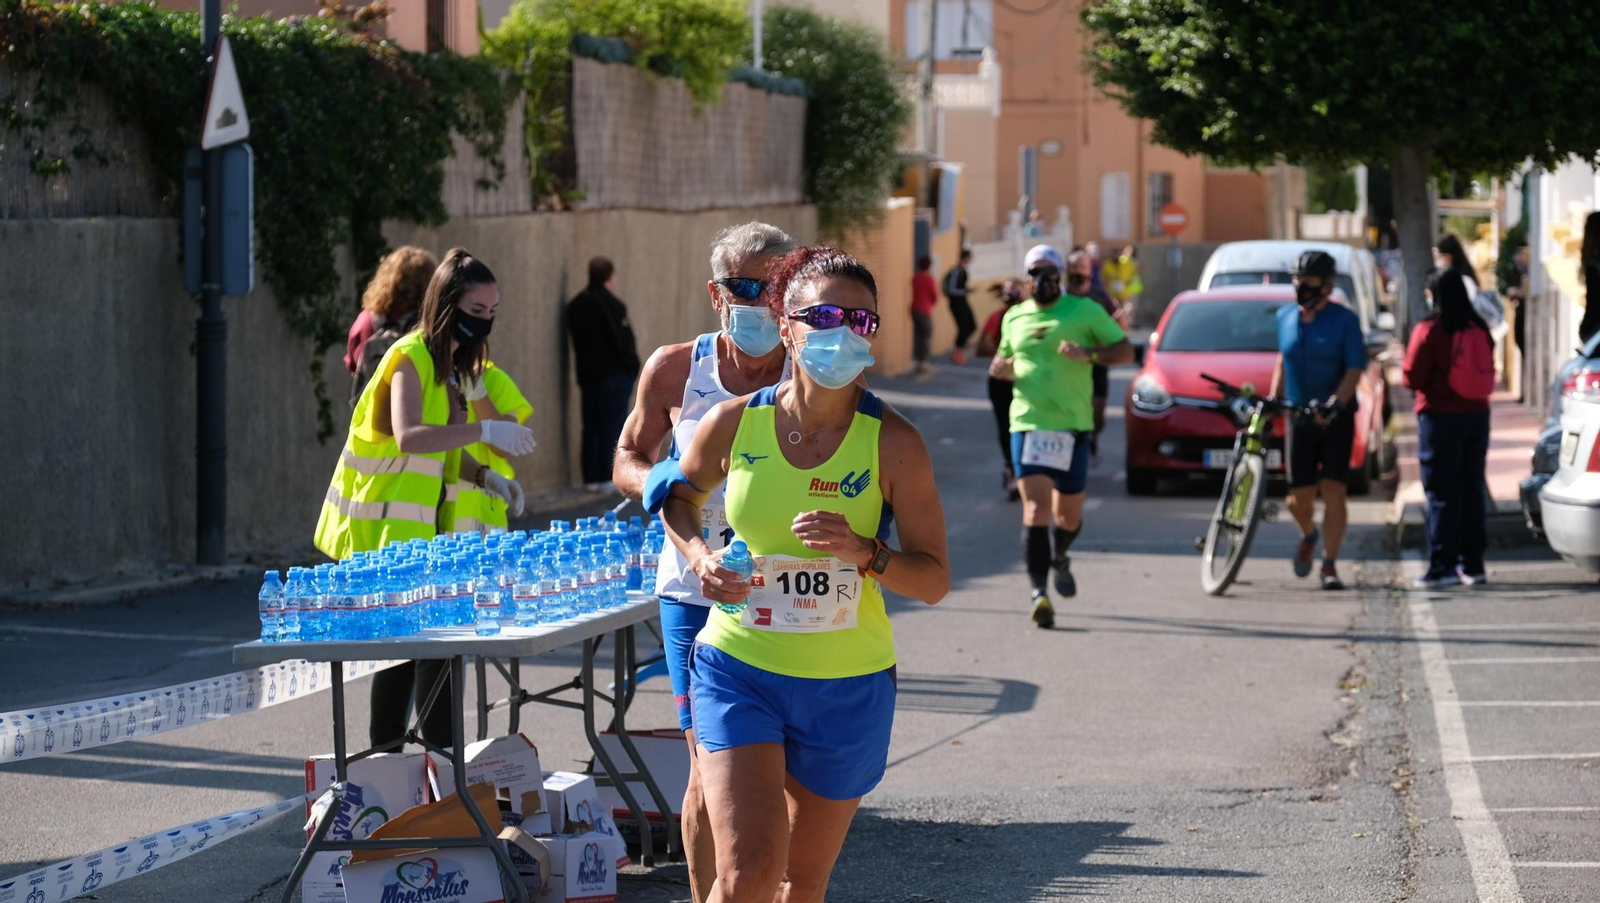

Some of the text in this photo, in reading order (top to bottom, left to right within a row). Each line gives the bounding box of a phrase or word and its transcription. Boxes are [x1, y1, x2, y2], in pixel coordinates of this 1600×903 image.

[809, 477, 839, 492] Run
[842, 484, 857, 496] 04
[776, 571, 830, 596] 108
[793, 598, 818, 609] INMA
